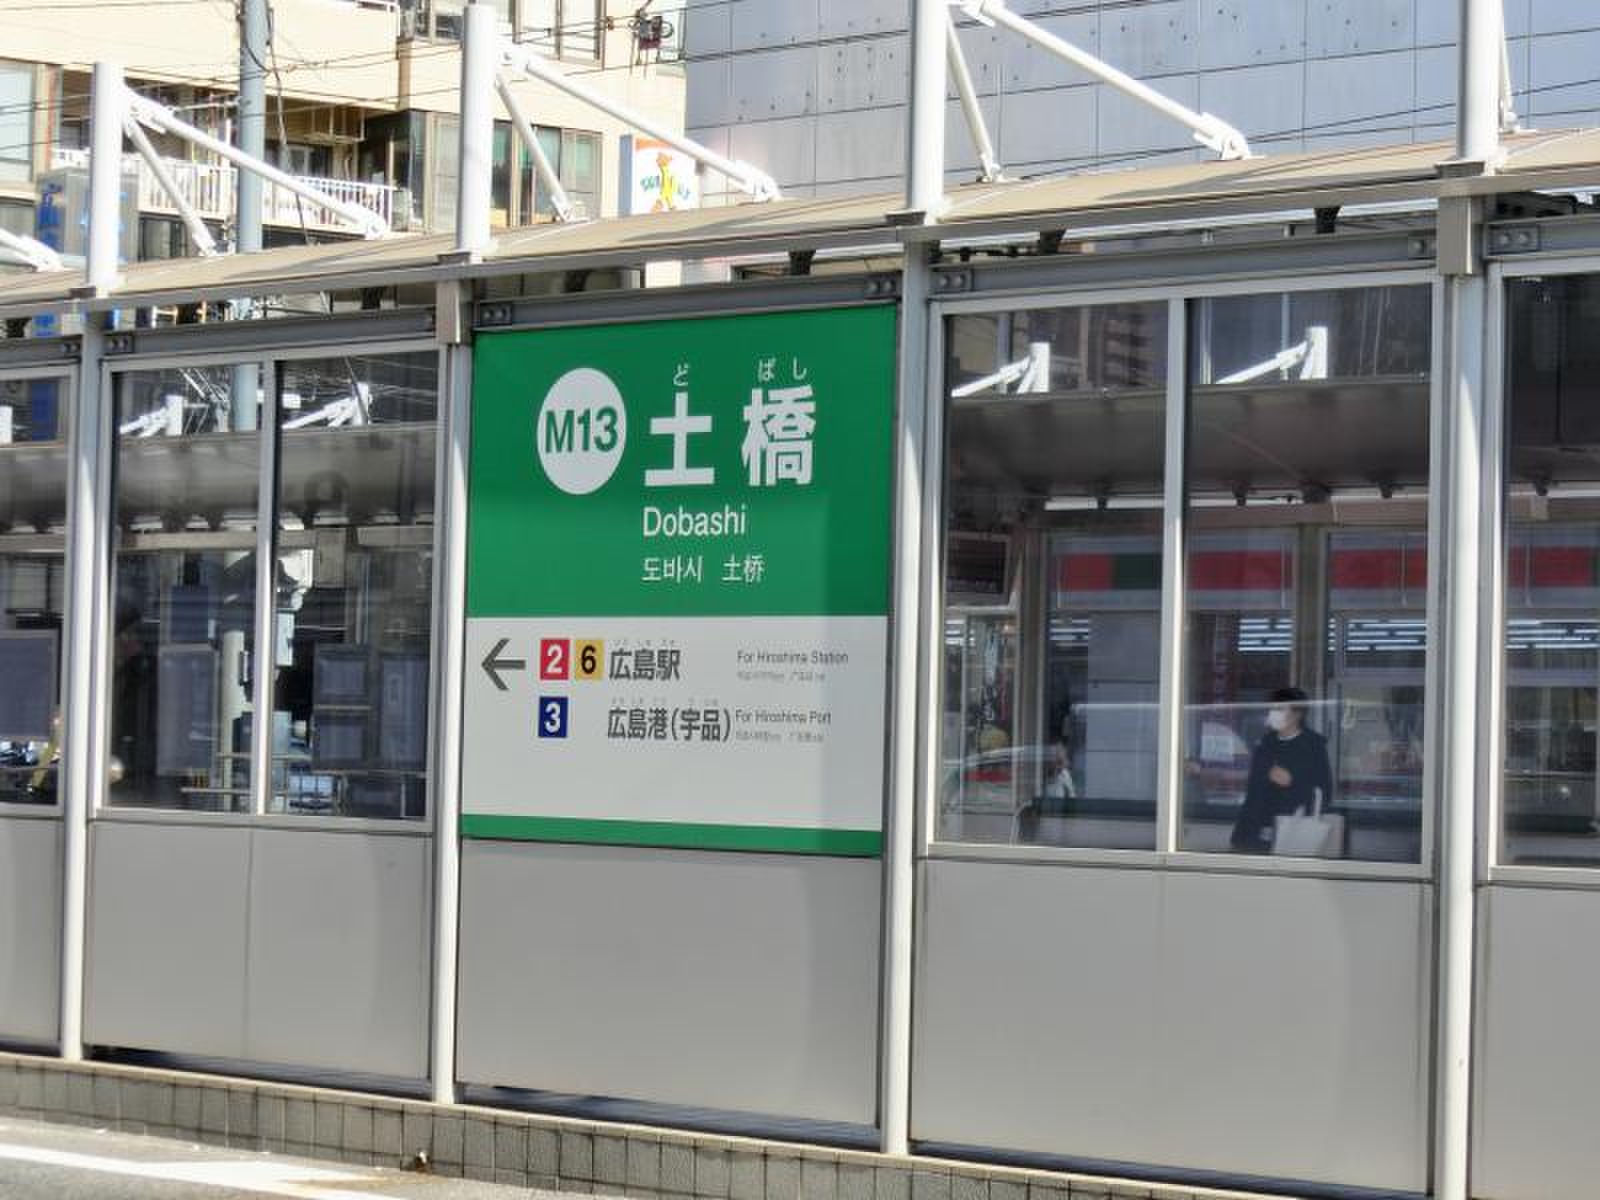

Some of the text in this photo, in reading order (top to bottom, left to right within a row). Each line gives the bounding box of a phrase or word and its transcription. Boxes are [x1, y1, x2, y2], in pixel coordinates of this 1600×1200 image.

[673, 363, 690, 386] ど
[544, 406, 619, 454] M13
[645, 384, 816, 487] 土橋
[642, 504, 748, 538] Dobashi
[641, 555, 703, 583] 도바시
[545, 645, 680, 681] 2 6 広島駅
[737, 650, 754, 663] For
[811, 650, 849, 664] Station
[545, 702, 562, 732] 3
[735, 709, 752, 723] For
[810, 711, 832, 725] Port
